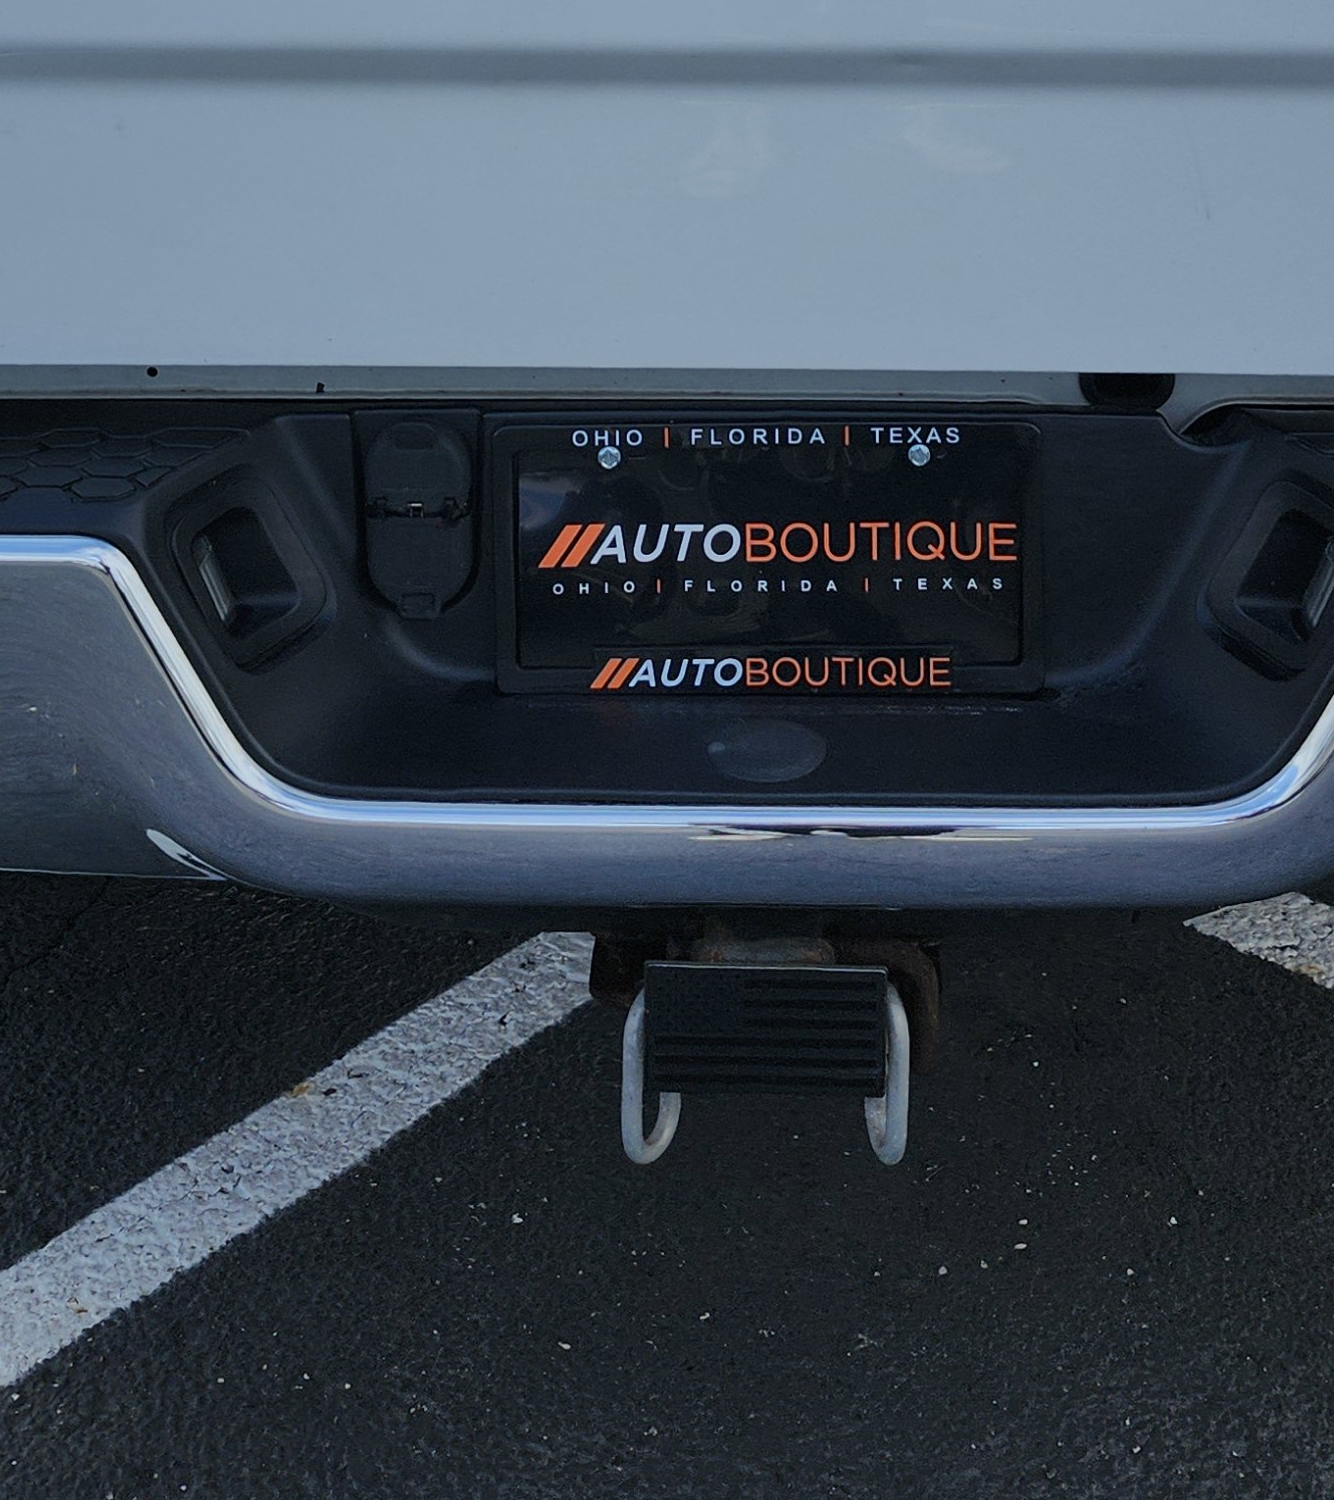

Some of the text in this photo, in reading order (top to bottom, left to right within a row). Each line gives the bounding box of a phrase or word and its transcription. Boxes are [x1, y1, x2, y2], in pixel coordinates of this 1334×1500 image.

[571, 426, 961, 448] OHIO FLORIDA TEXAS
[552, 577, 1004, 595] OHIO FLORIDA TEXAS
